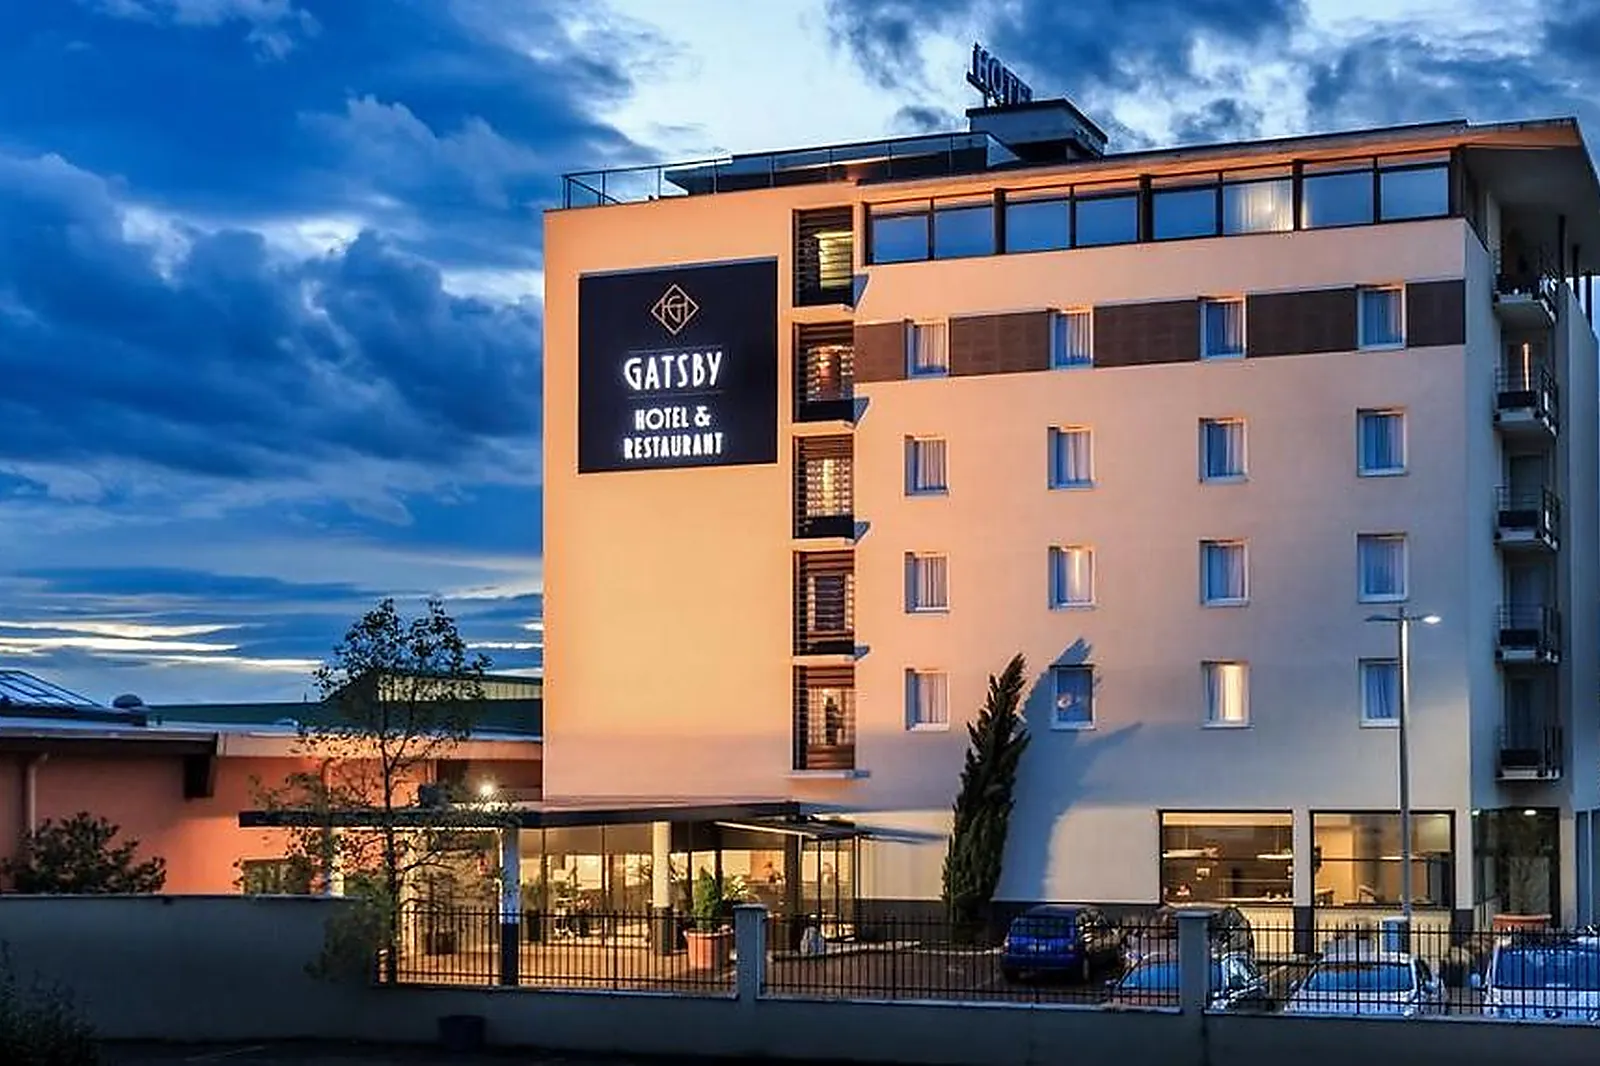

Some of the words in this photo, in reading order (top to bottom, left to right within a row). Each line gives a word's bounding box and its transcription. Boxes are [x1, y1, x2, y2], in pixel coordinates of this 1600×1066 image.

[624, 351, 722, 390] GATSBY
[635, 407, 689, 430] HOTEL
[694, 406, 711, 426] &
[624, 432, 723, 459] RESTAURANT
